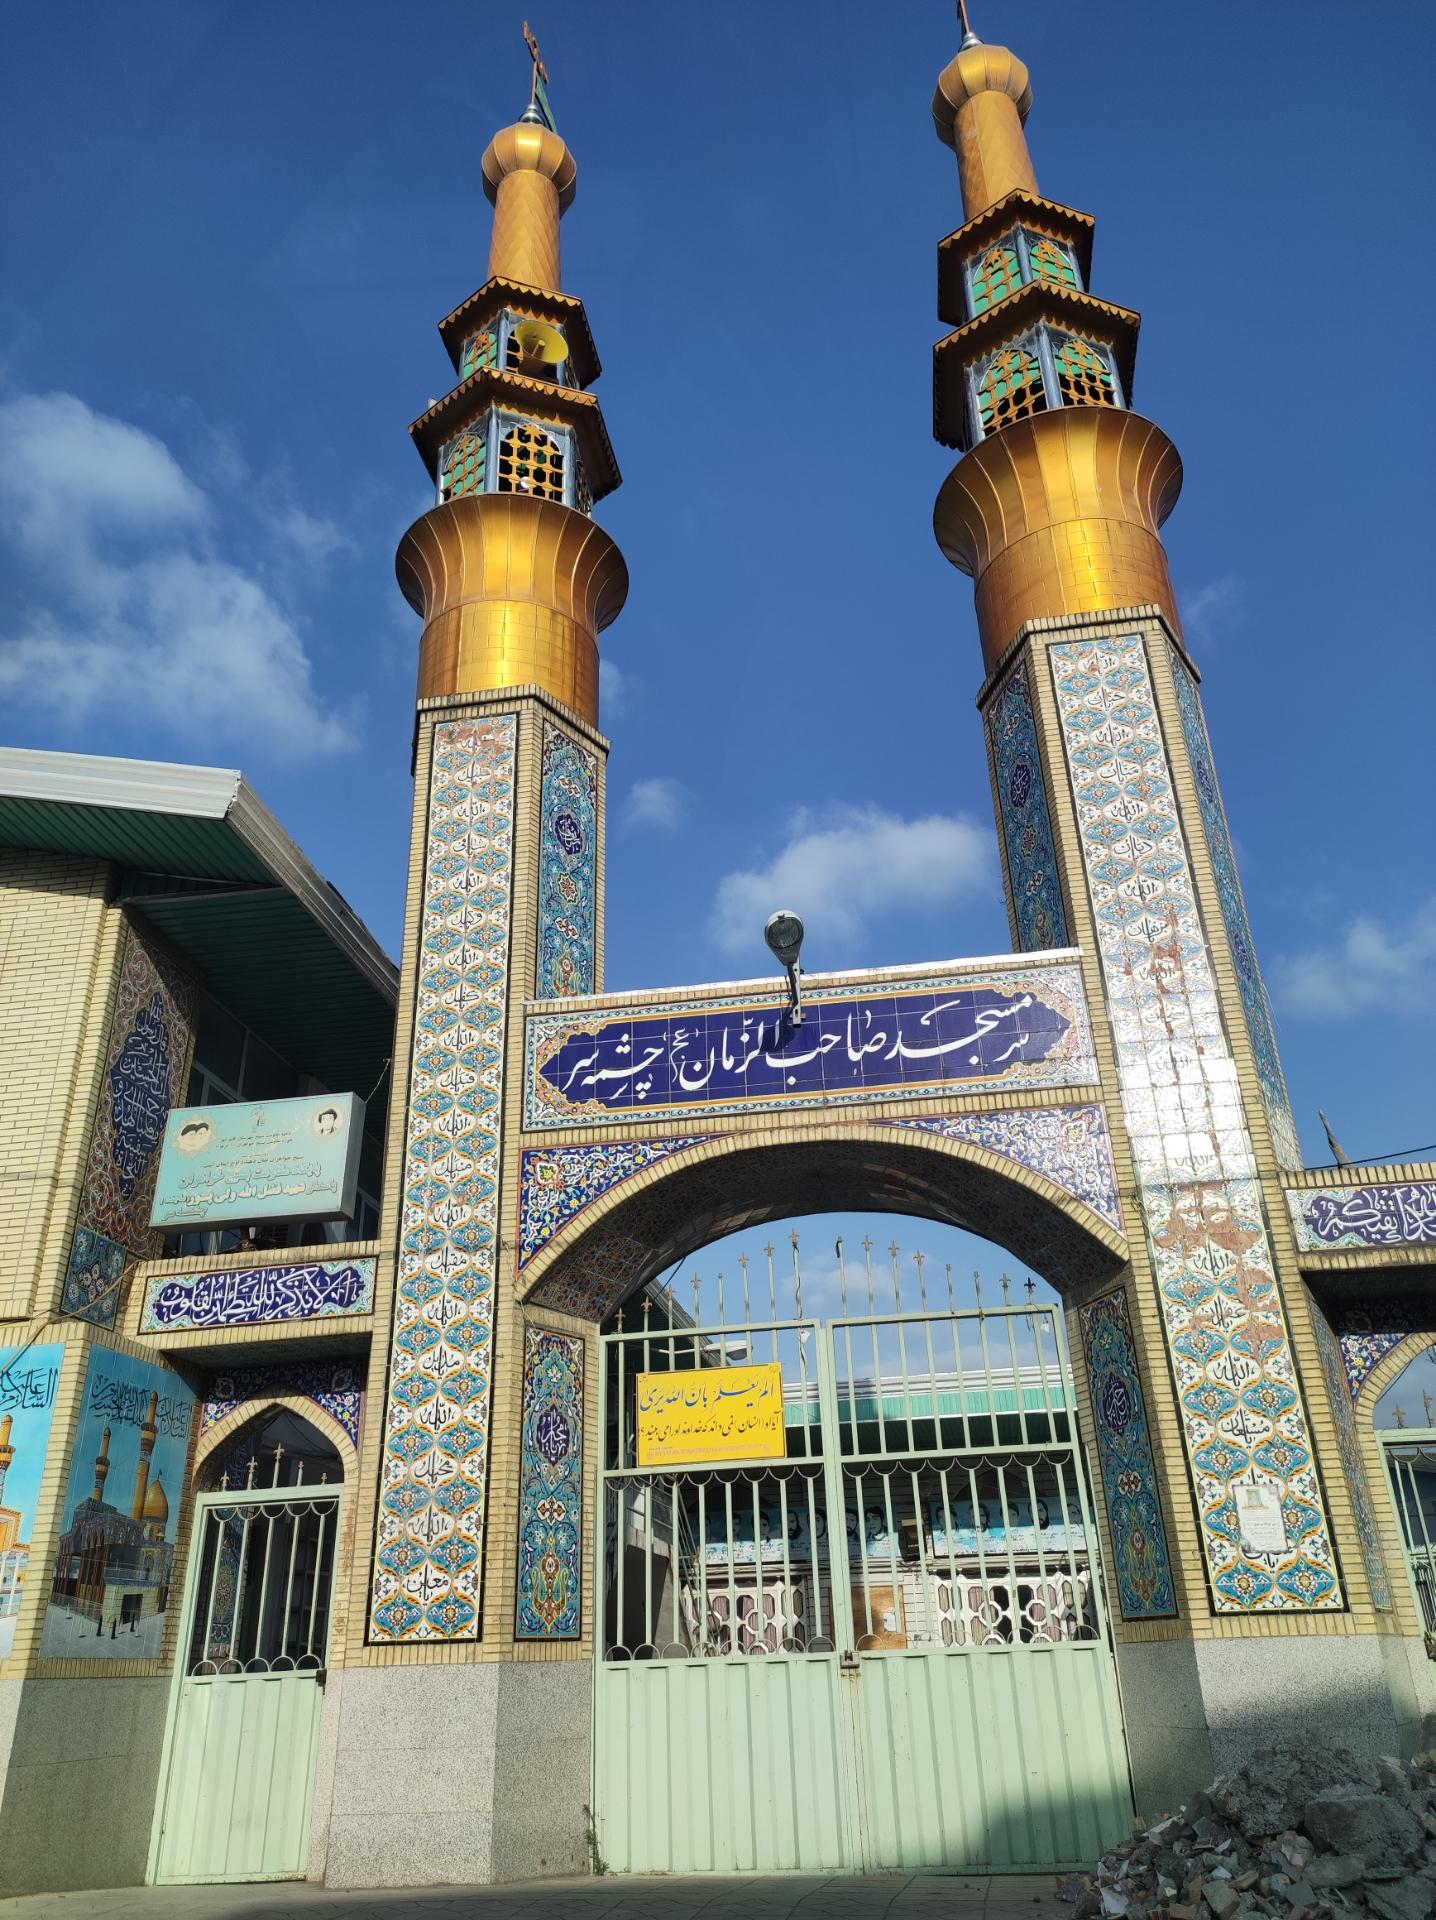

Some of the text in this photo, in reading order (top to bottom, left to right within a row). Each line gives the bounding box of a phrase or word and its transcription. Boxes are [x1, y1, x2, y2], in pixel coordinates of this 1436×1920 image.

[677, 1017, 781, 1092] الزمان
[765, 1009, 887, 1087] صاحب
[885, 995, 1033, 1066] مسجد
[562, 1047, 600, 1092] سر
[580, 1033, 665, 1100] چشمه
[663, 1386, 685, 1405] الله
